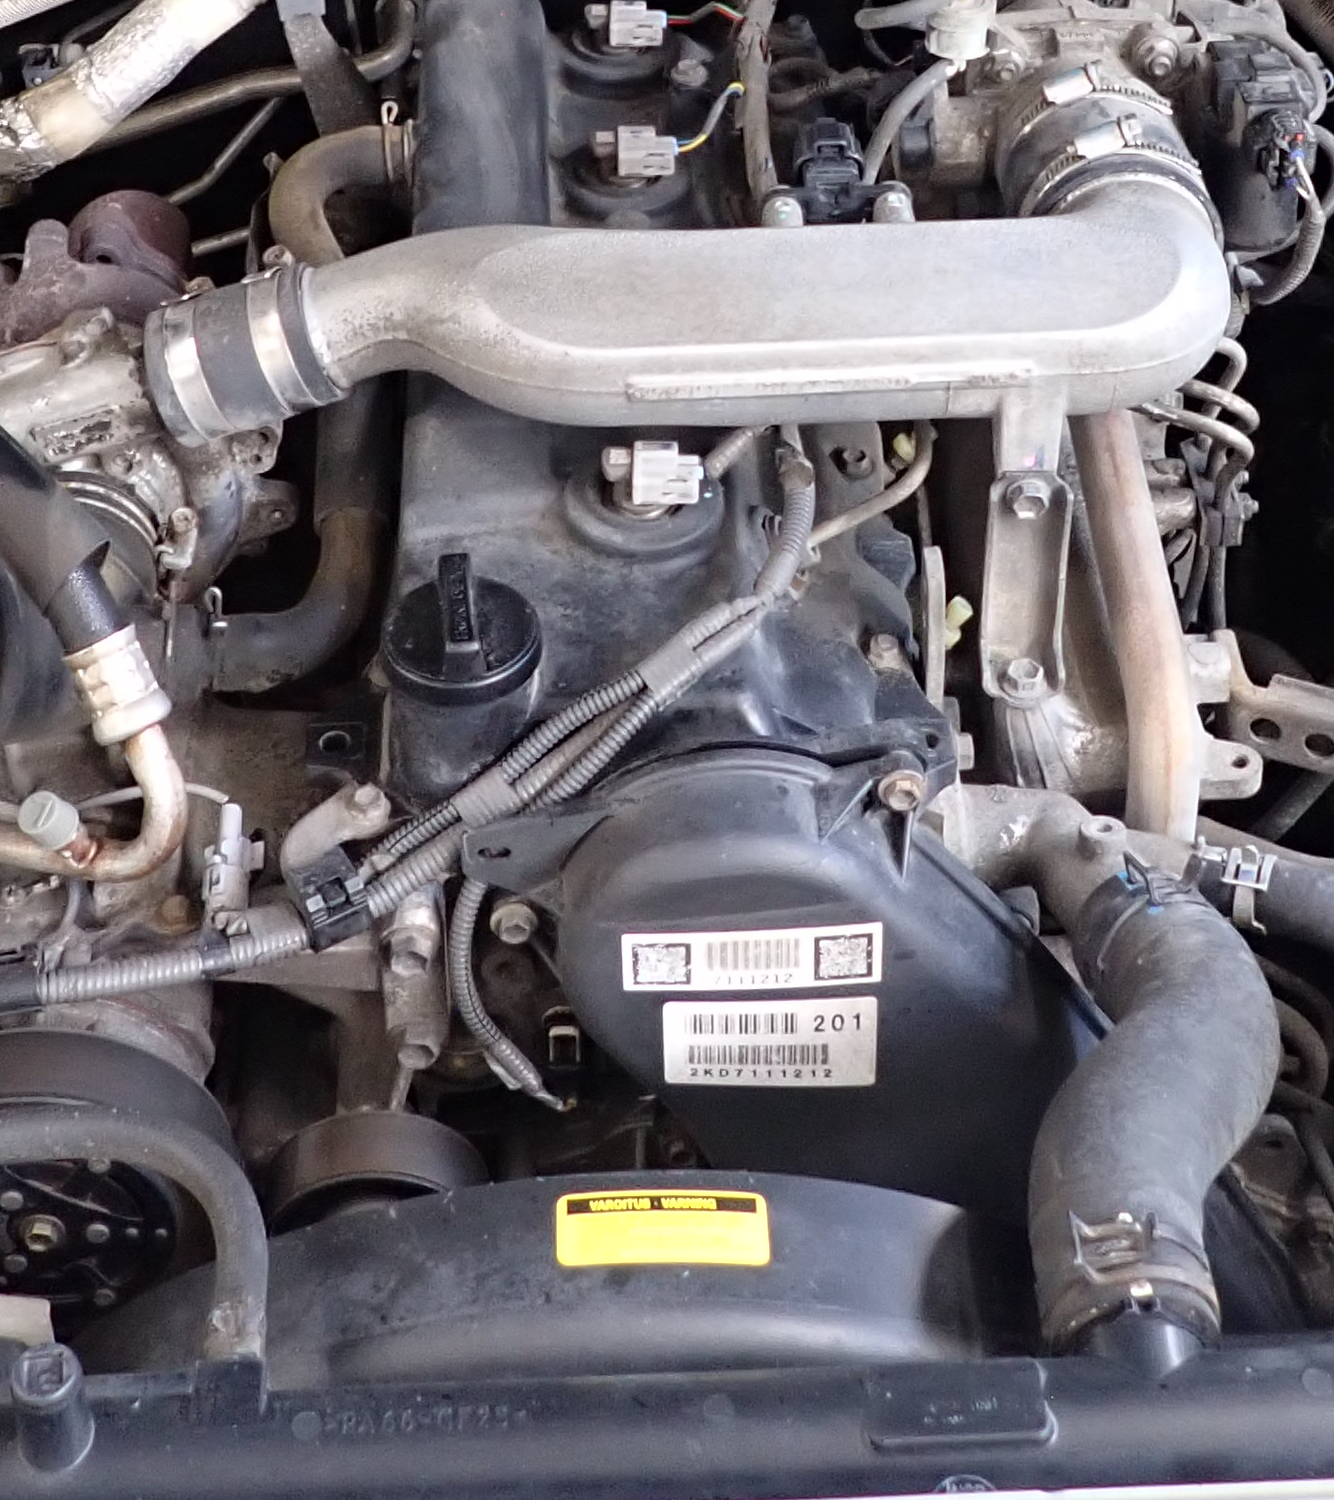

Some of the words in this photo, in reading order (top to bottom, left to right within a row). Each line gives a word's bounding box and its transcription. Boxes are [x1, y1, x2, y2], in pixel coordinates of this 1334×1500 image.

[813, 1012, 863, 1033] 201
[689, 1067, 833, 1079] 2KD7111212
[589, 1197, 652, 1212] VAROITUS
[660, 1197, 718, 1210] VARNING
